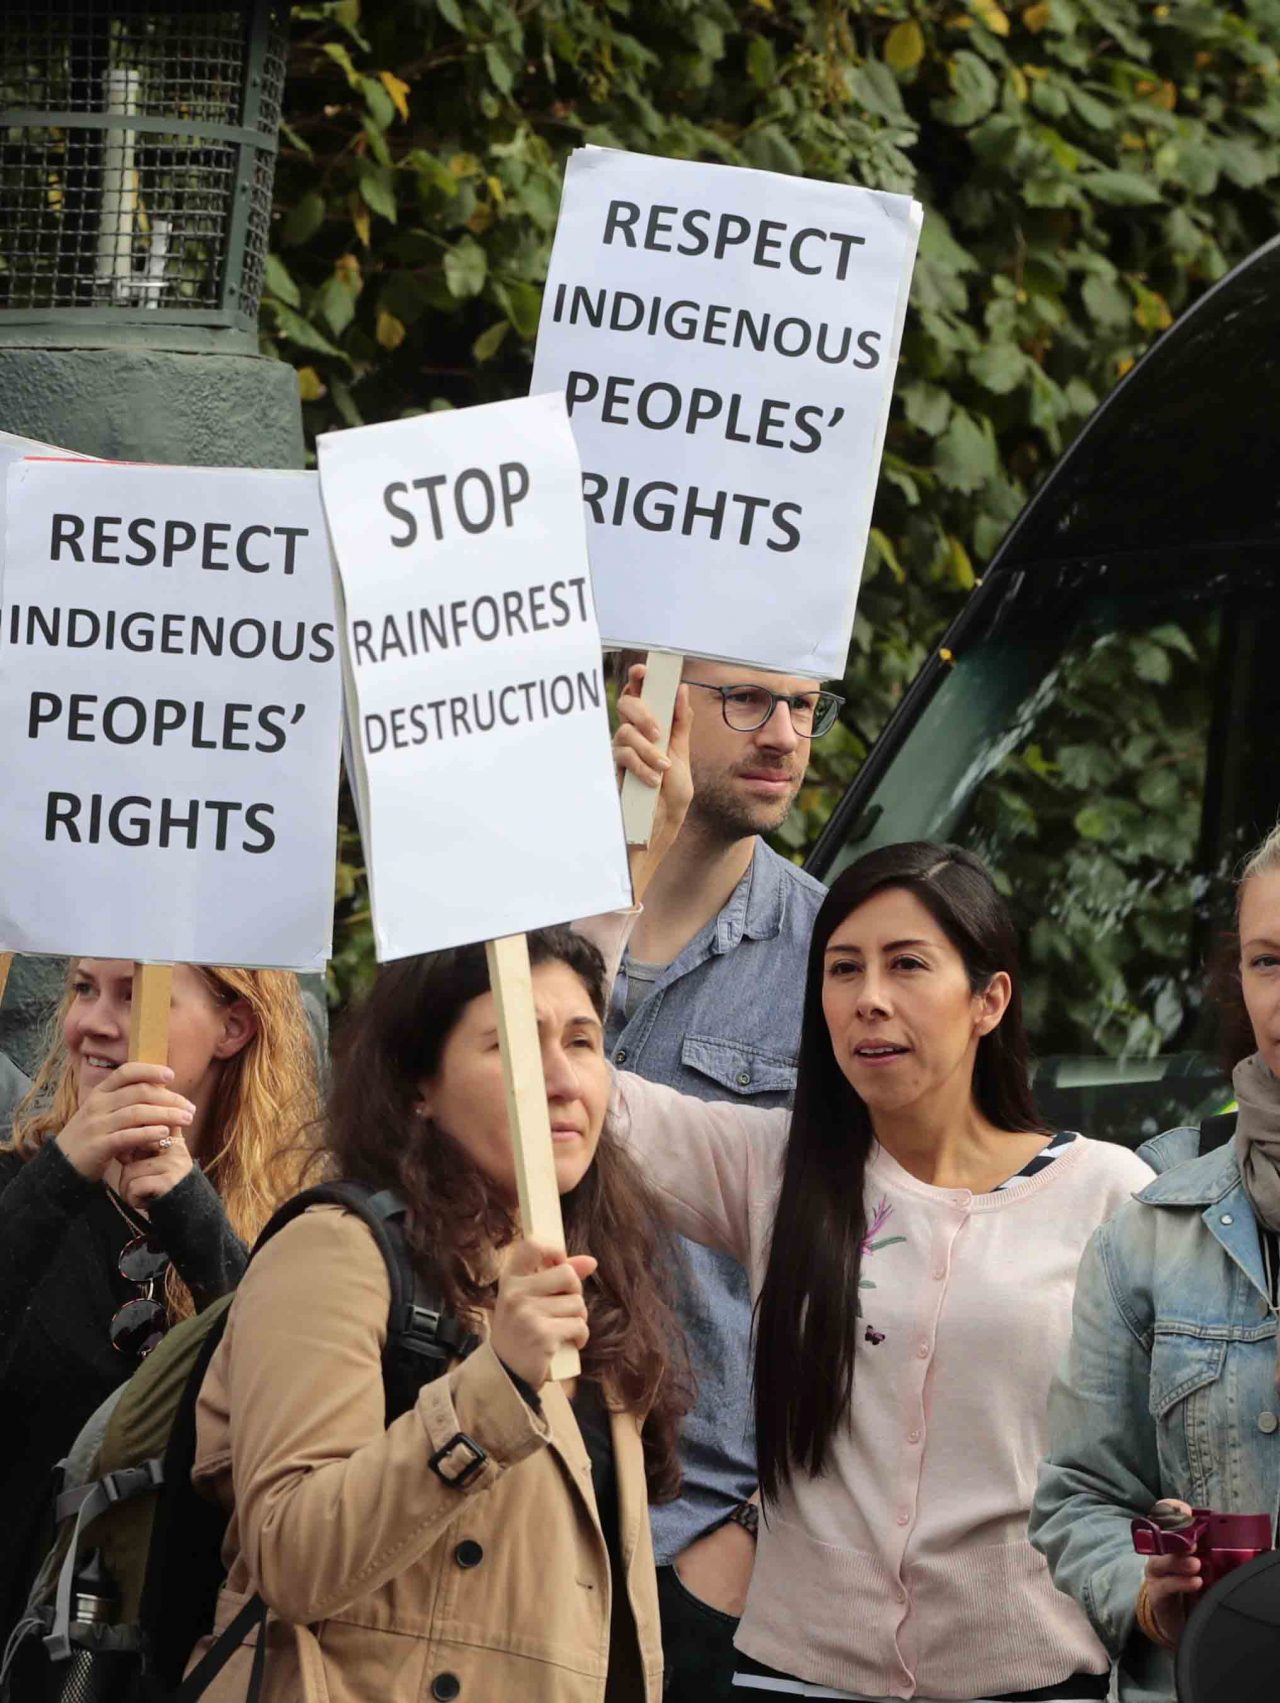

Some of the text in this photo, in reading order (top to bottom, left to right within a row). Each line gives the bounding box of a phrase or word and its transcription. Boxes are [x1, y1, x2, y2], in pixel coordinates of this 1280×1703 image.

[603, 200, 865, 280] RESPECT
[553, 284, 880, 369] INDIGENOUS
[566, 371, 844, 453] PEOPLES’
[51, 514, 309, 574] RESPECT
[384, 462, 529, 548] STOP
[582, 472, 802, 552] RIGHTS
[10, 605, 334, 663] INDIGENOUS
[353, 577, 586, 665] RAINFOREST
[29, 692, 305, 753] PEOPLES’
[365, 669, 600, 754] DESTRUCTION
[45, 792, 275, 853] RIGHTS
